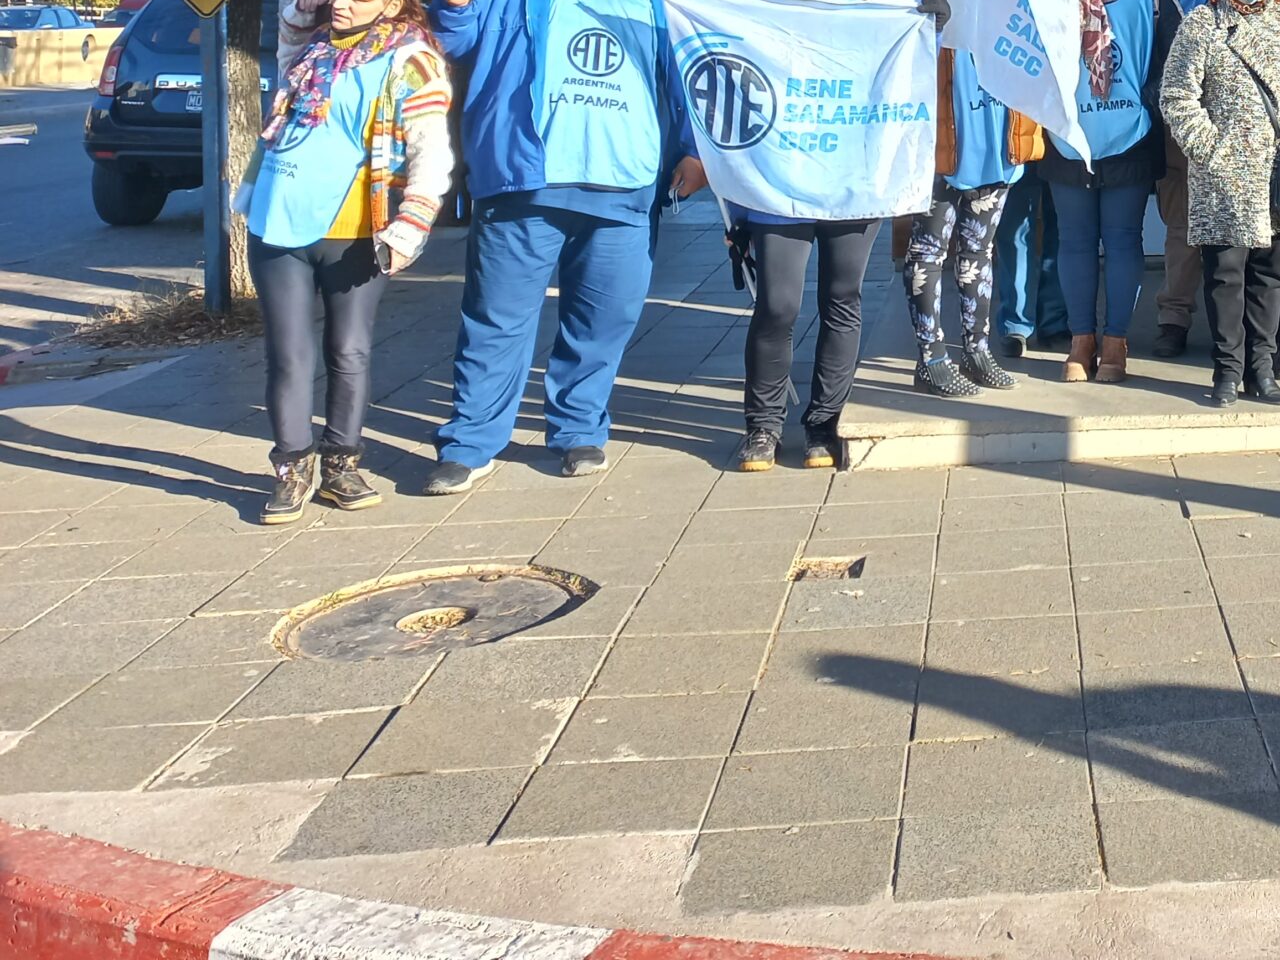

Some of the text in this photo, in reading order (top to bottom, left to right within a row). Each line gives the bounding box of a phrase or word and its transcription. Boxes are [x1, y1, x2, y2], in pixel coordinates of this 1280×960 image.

[570, 30, 621, 73] ATE
[994, 35, 1043, 77] CCC
[562, 77, 622, 92] ARGENTINA
[786, 77, 854, 99] RENE
[573, 94, 630, 113] PAMPA
[686, 55, 771, 146] ATE
[1080, 99, 1134, 113] LA PAMPA
[783, 102, 931, 125] SALAMANCA
[778, 131, 839, 153] CCC
